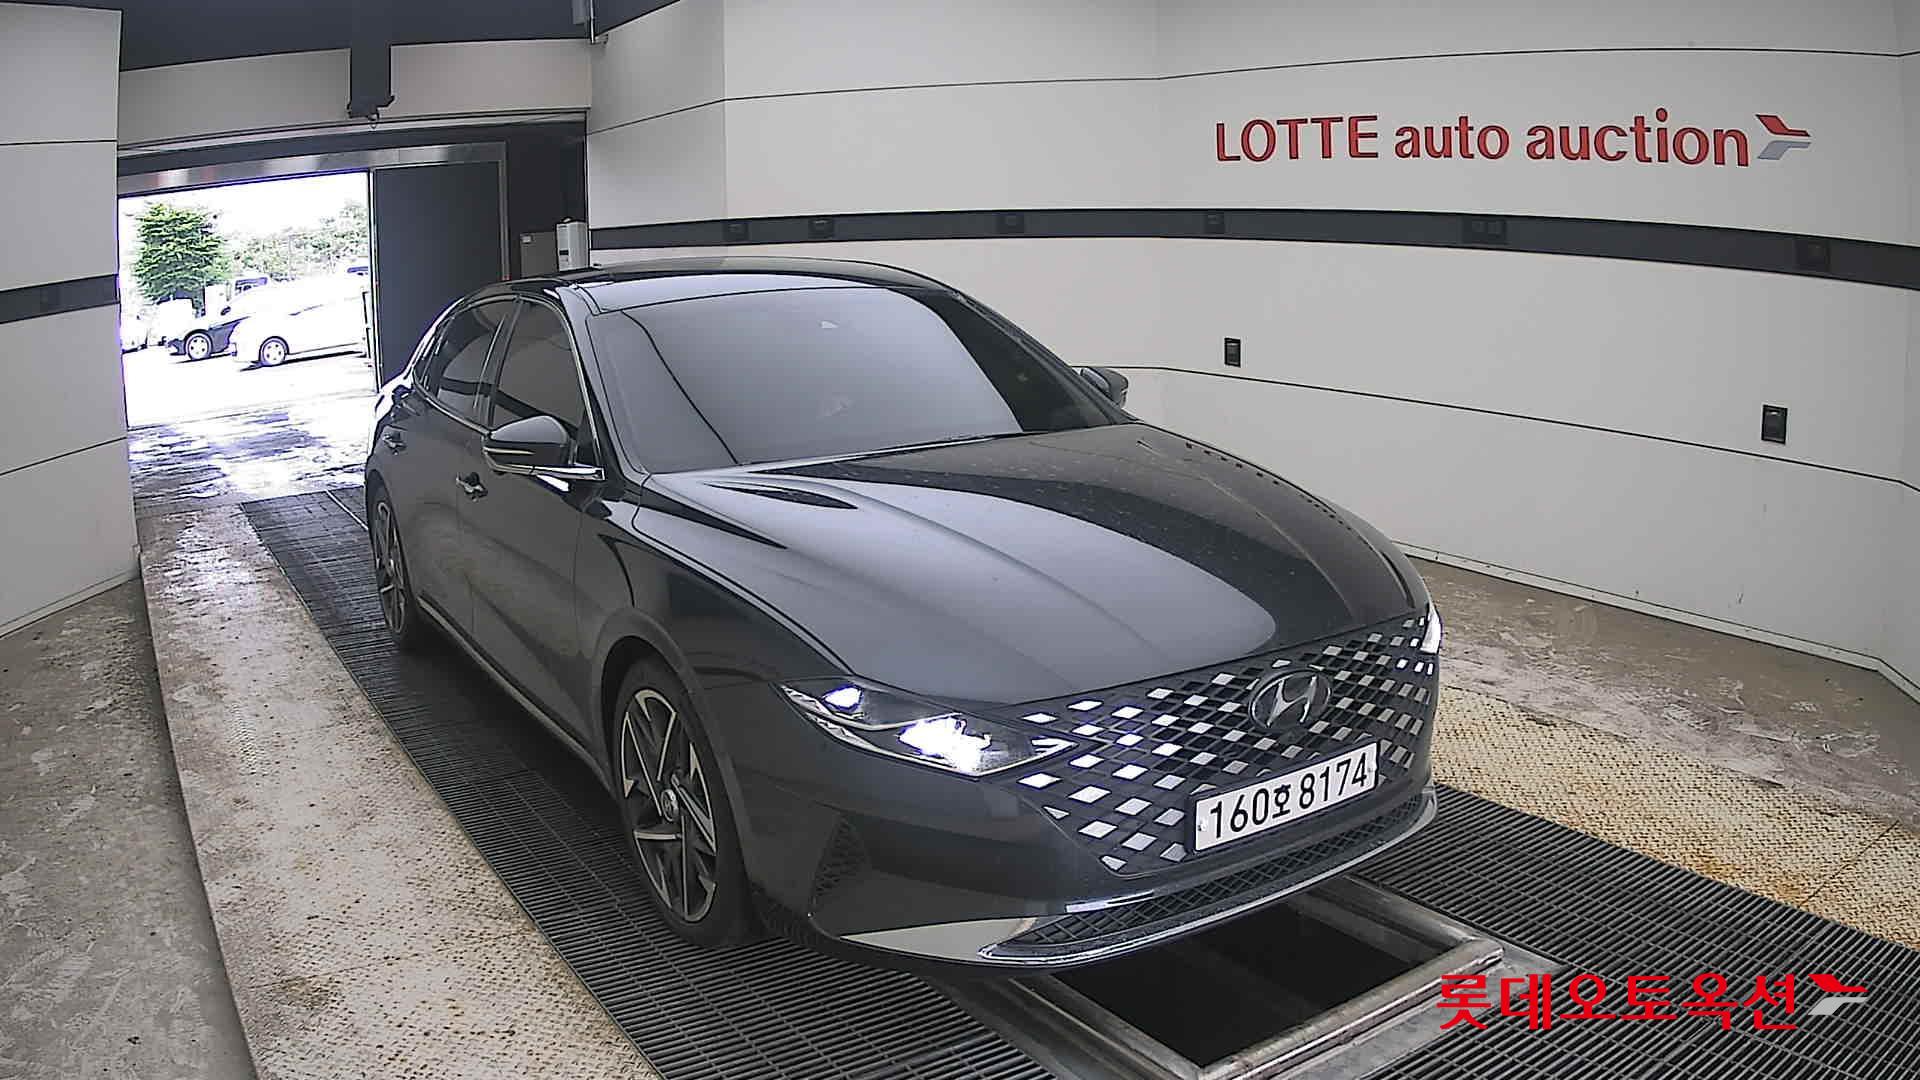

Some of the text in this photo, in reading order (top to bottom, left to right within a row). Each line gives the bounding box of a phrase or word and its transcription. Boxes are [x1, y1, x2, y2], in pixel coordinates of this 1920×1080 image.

[1215, 107, 1750, 167] LOTTE auto auction
[1210, 752, 1367, 838] 160호 8174
